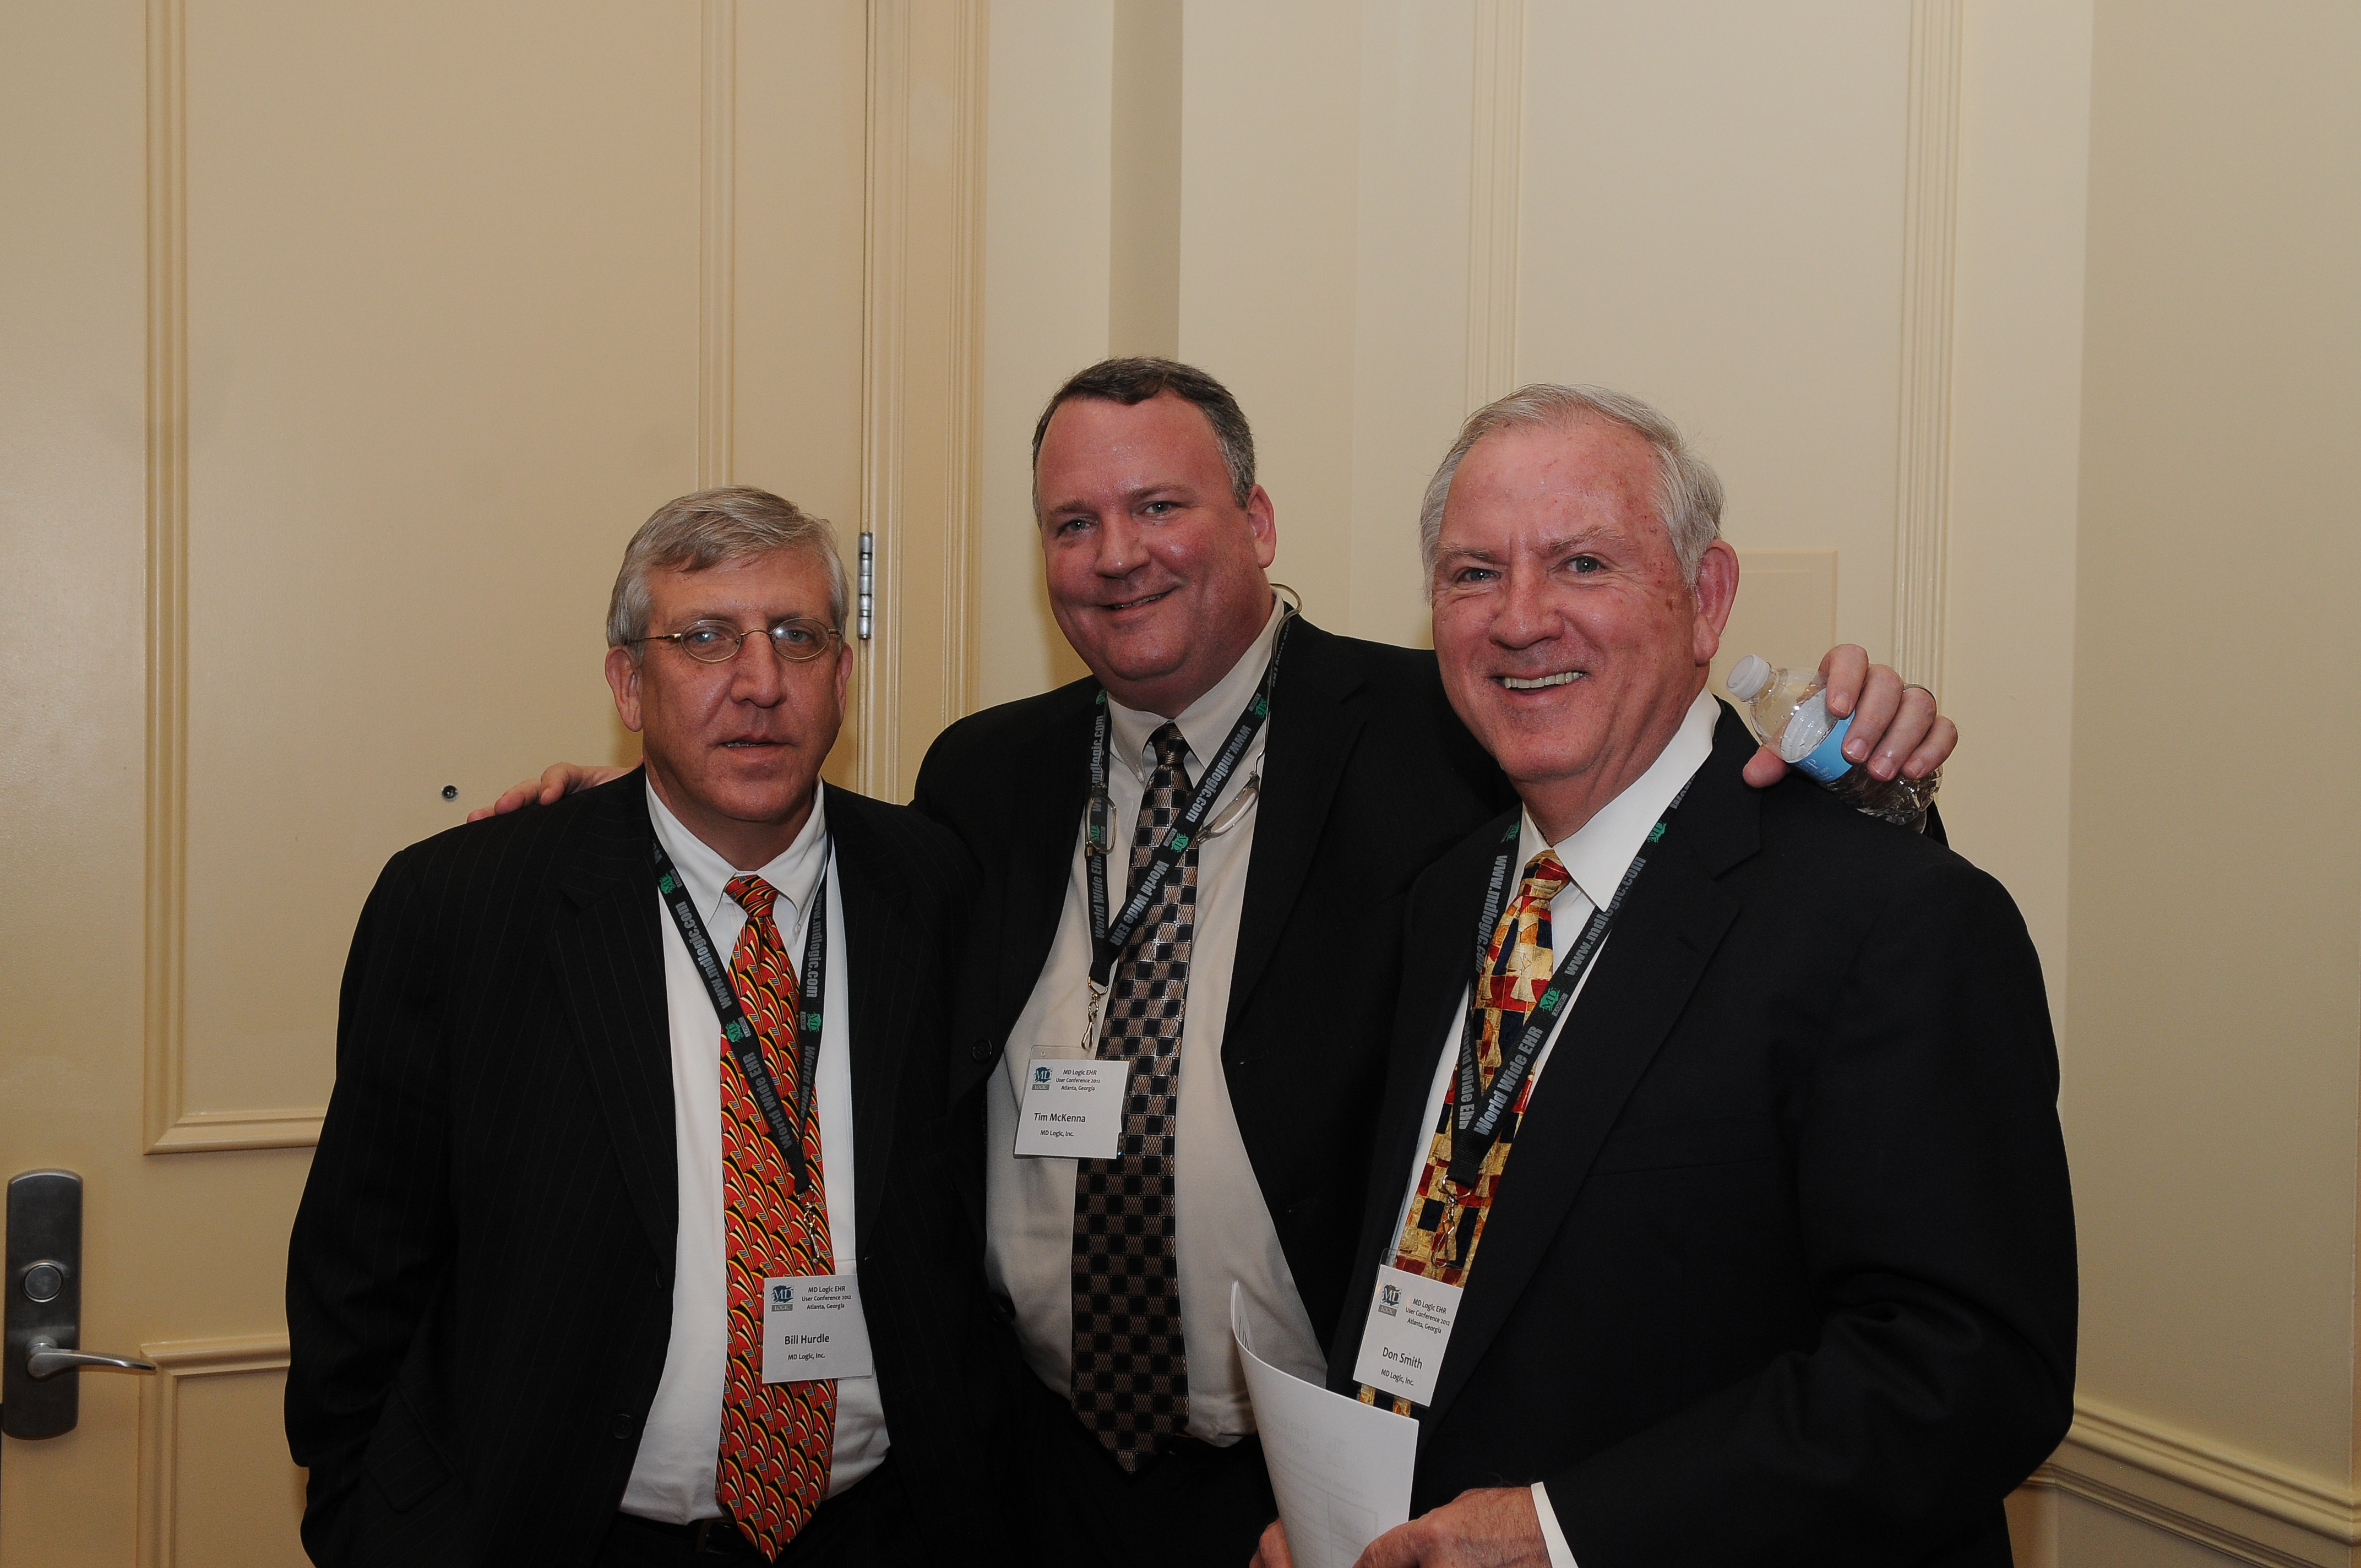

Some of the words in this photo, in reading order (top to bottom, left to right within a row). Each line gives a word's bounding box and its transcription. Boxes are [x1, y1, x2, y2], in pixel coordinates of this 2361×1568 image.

[1185, 725, 1252, 823] www.mdlogic.com
[1092, 875, 1103, 904] Wide
[1140, 860, 1169, 896] World
[1123, 893, 1149, 924] Wide
[1095, 905, 1105, 939] World
[1109, 922, 1131, 946] EHR
[675, 901, 732, 1009] www.mdlogic.com
[1539, 988, 1560, 1011] MD
[1552, 993, 1568, 1017] LOGIC
[807, 1012, 822, 1032] MD
[742, 1052, 763, 1078] EHR
[803, 1046, 815, 1085] World
[1461, 1064, 1475, 1103] Wide
[1473, 1090, 1508, 1136] World
[1497, 1054, 1527, 1092] Wide
[1518, 1026, 1543, 1055] EHR
[755, 1077, 777, 1112] Wide
[769, 1109, 793, 1150] World
[1033, 1113, 1048, 1121] Tim
[1049, 1113, 1086, 1123] McKenna
[1379, 1305, 1395, 1316] LOGIC
[1412, 1298, 1422, 1307] MD
[1422, 1300, 1435, 1313] Logic
[1436, 1305, 1447, 1315] EHR
[1416, 1310, 1440, 1323] Conference
[785, 1335, 798, 1344] Bill
[801, 1333, 830, 1344] Hurdle
[1407, 1317, 1424, 1329] Atlanta,
[1424, 1324, 1441, 1335] Georgia
[1382, 1347, 1399, 1361] Don
[1399, 1353, 1423, 1370] Smith
[1380, 1368, 1390, 1377] MD
[1390, 1370, 1405, 1384] Logic,
[1405, 1377, 1414, 1386] Inc.
